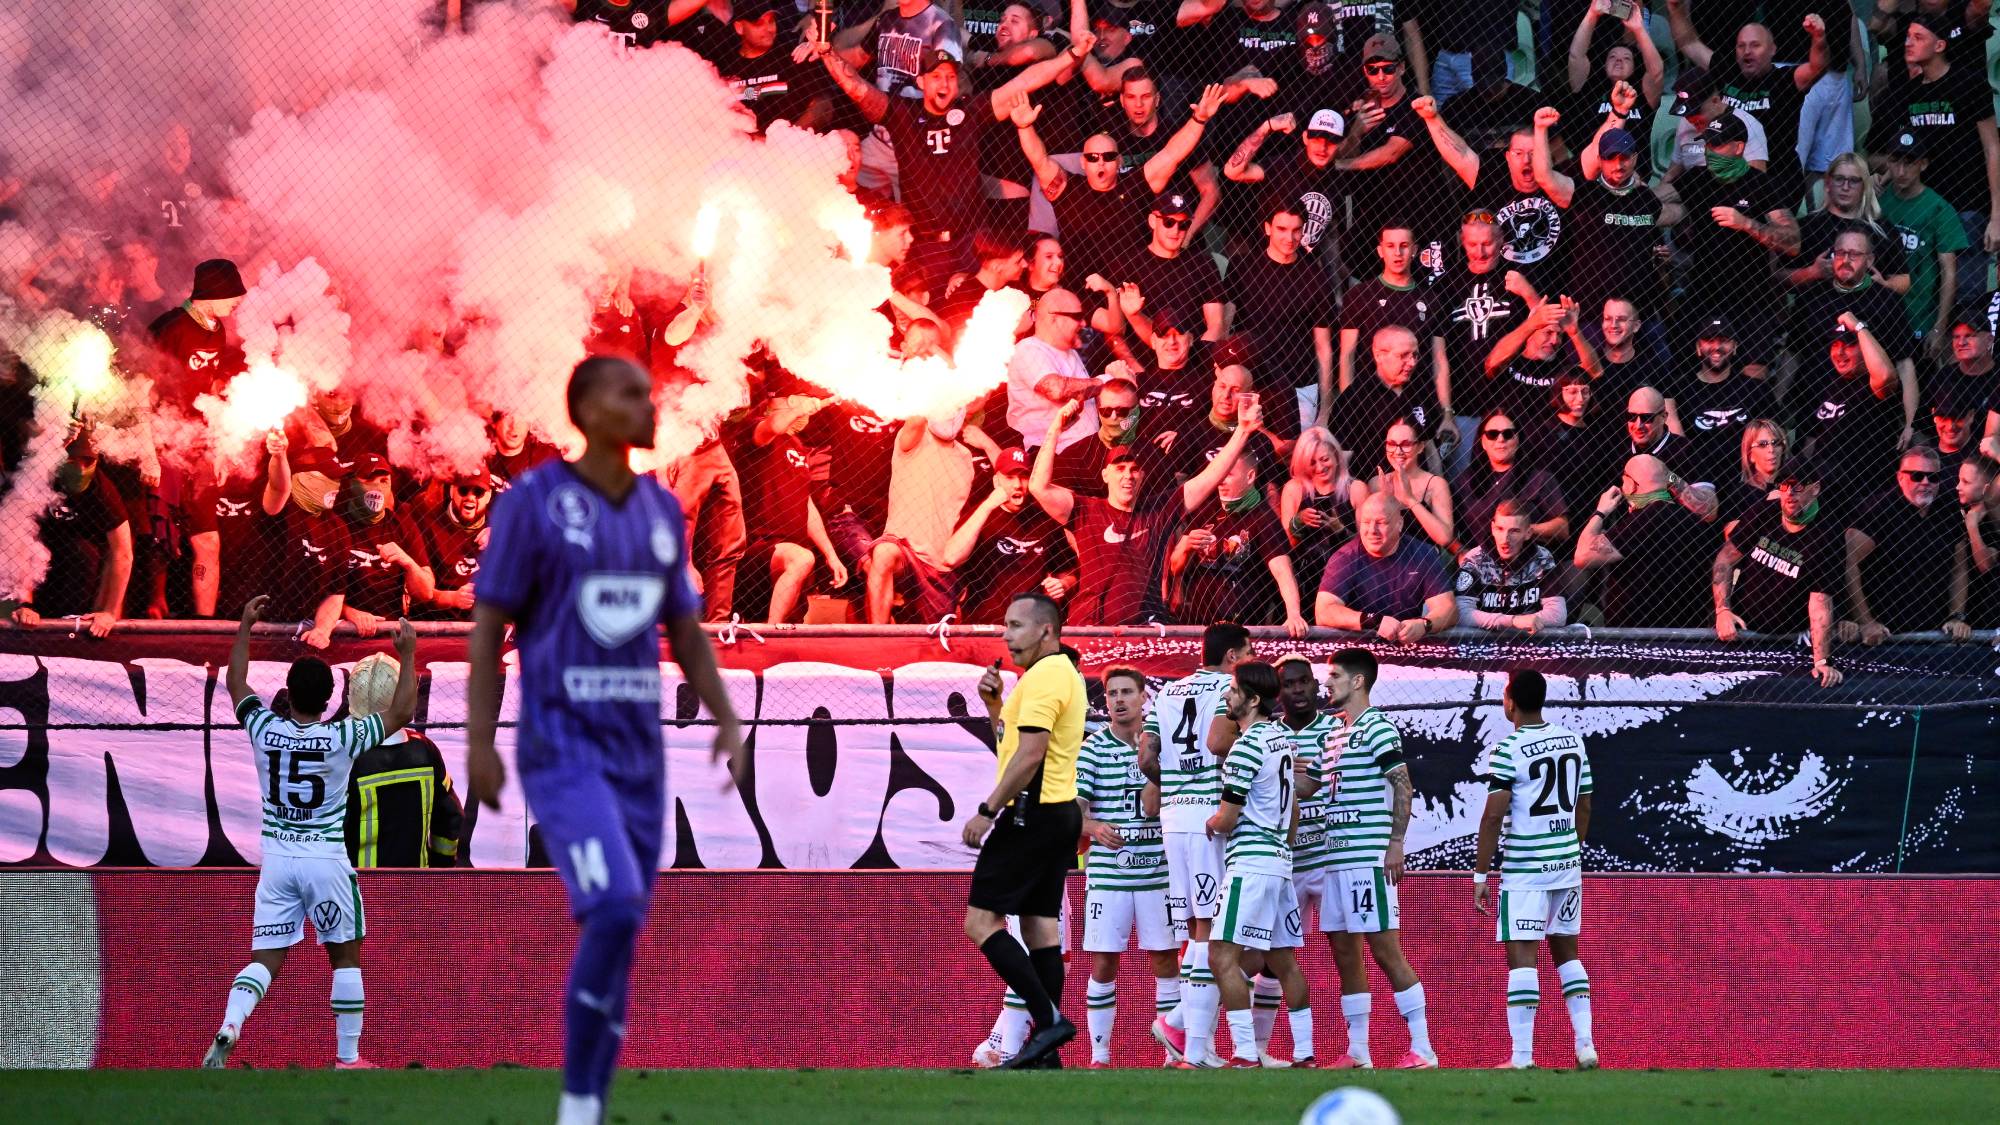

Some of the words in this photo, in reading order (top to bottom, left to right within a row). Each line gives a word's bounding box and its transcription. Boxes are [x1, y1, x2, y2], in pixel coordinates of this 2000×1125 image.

[926, 128, 951, 154] T
[1172, 697, 1200, 755] 4
[264, 750, 326, 809] 15
[1278, 754, 1292, 816] 6
[1528, 752, 1581, 817] 20
[276, 808, 314, 821] ARZANI
[1351, 888, 1375, 914] 14
